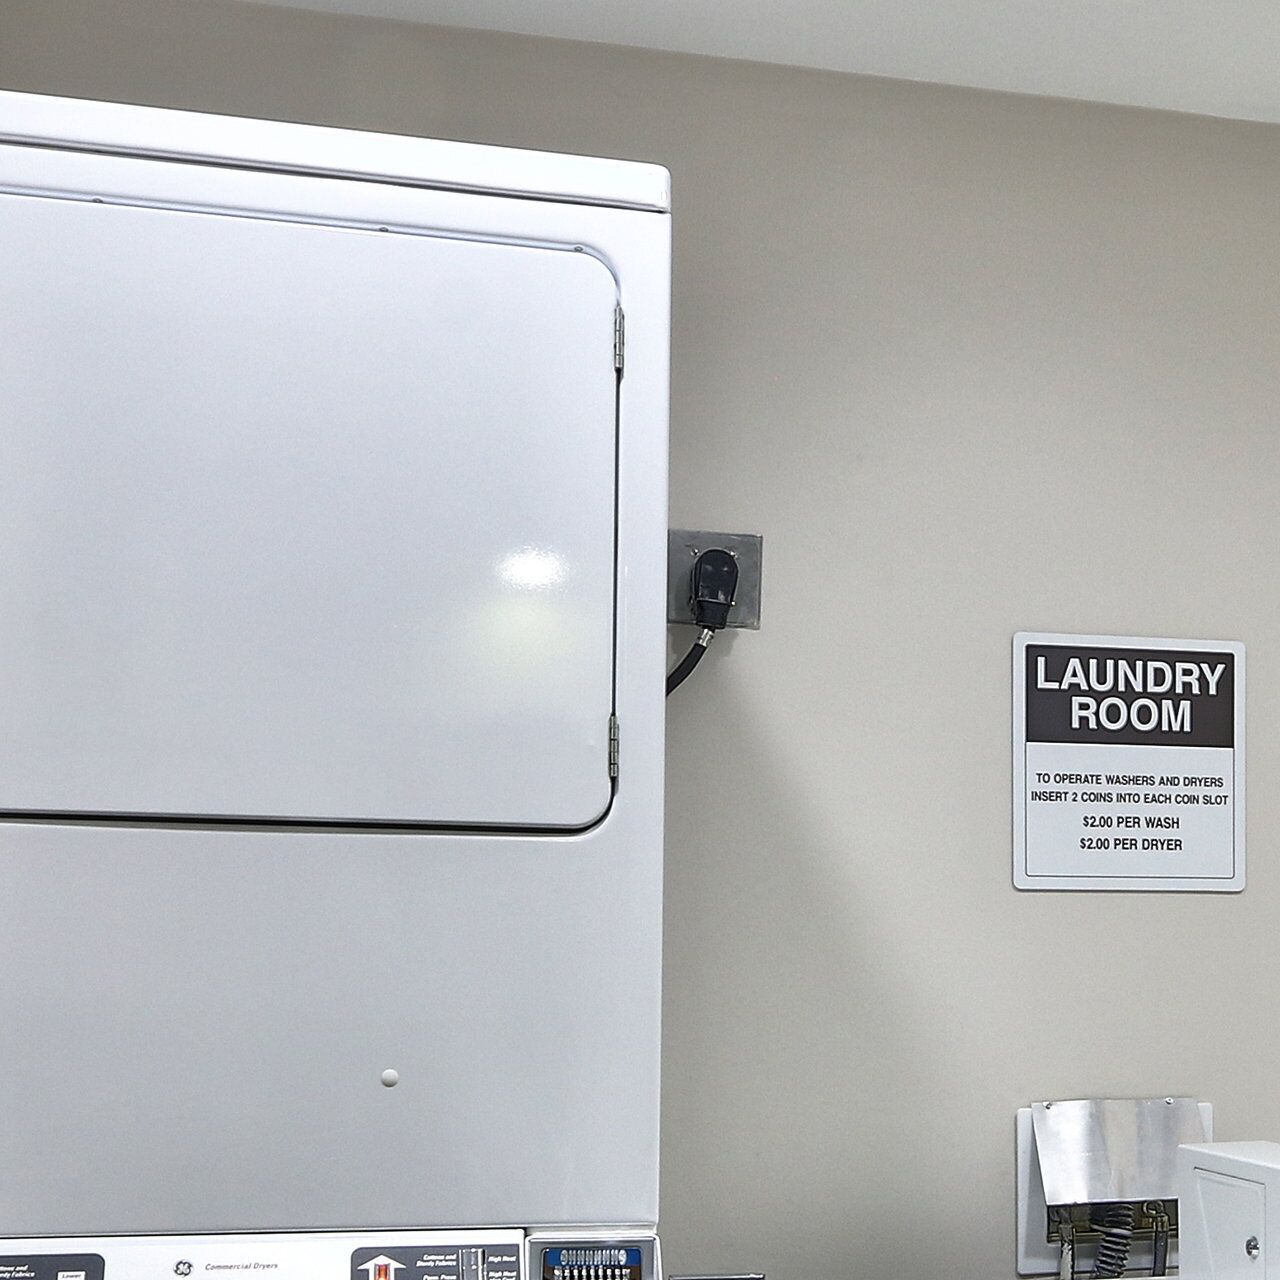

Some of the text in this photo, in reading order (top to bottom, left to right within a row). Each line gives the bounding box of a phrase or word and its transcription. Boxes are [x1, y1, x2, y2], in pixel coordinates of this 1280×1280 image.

[1036, 656, 1226, 695] LAUNDRY
[1070, 696, 1191, 732] ROOM
[1035, 772, 1224, 788] TO OPERATE WASHERS AND DRYERS
[1030, 790, 1229, 806] INSERT 2 COINS INTO EACH COIN SLOT
[1082, 815, 1180, 830] $2.00 PER WASH
[1079, 837, 1183, 851] $2.00 PER DRYER
[205, 1262, 278, 1271] Commercial Dryers
